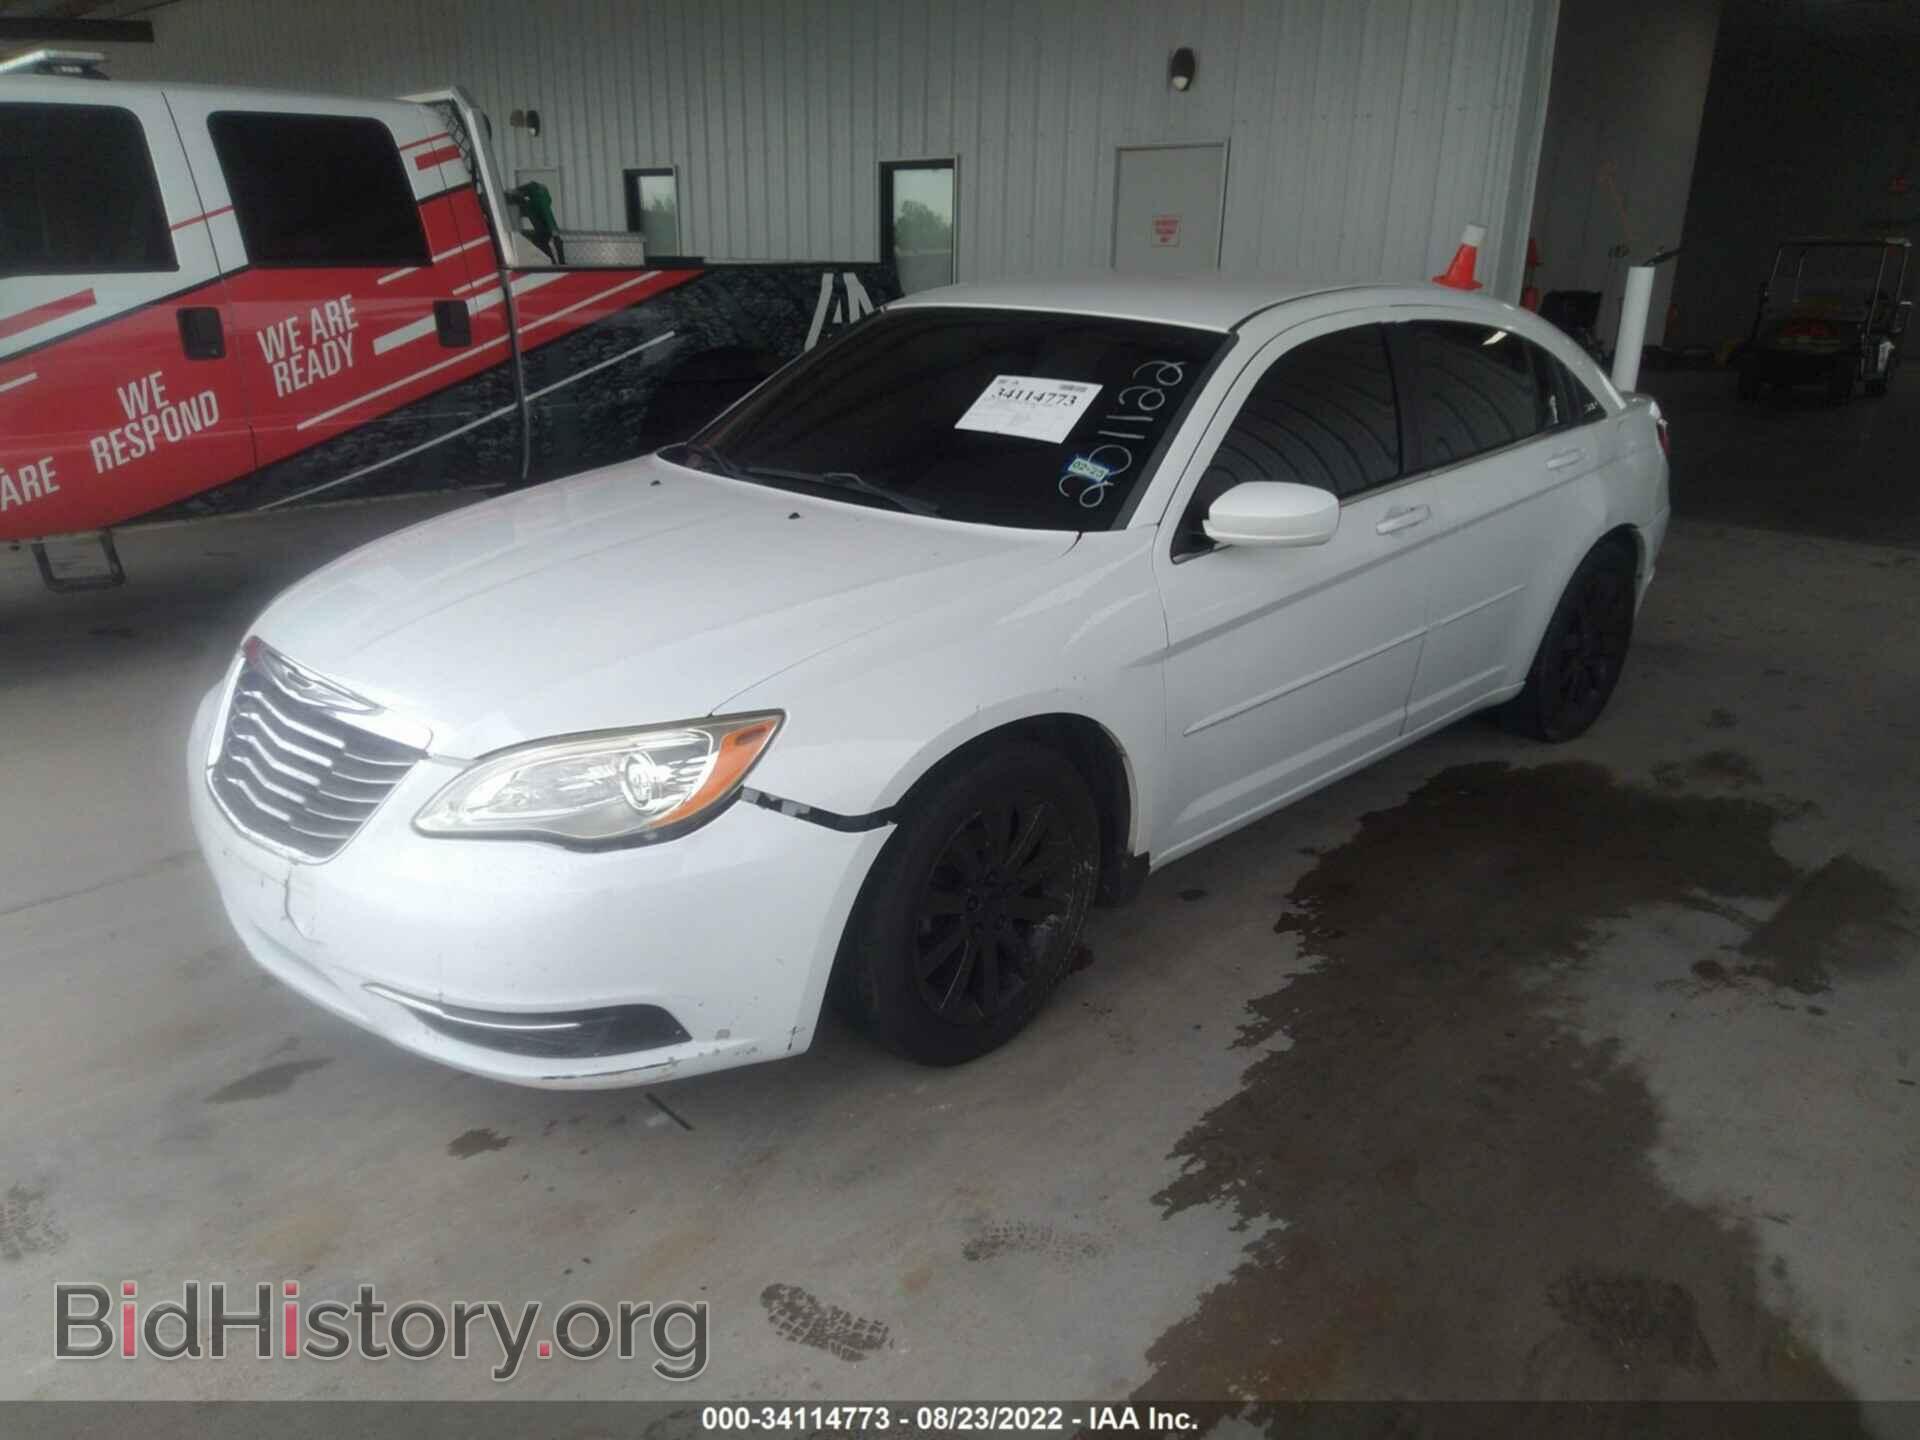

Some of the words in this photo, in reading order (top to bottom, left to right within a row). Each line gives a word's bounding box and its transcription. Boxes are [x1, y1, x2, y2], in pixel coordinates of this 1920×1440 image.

[256, 316, 302, 364] WE
[310, 294, 359, 345] ARE
[117, 371, 170, 420] WE
[272, 332, 354, 397] READY
[991, 387, 1078, 407] 34114773
[90, 390, 220, 474] RESPOND
